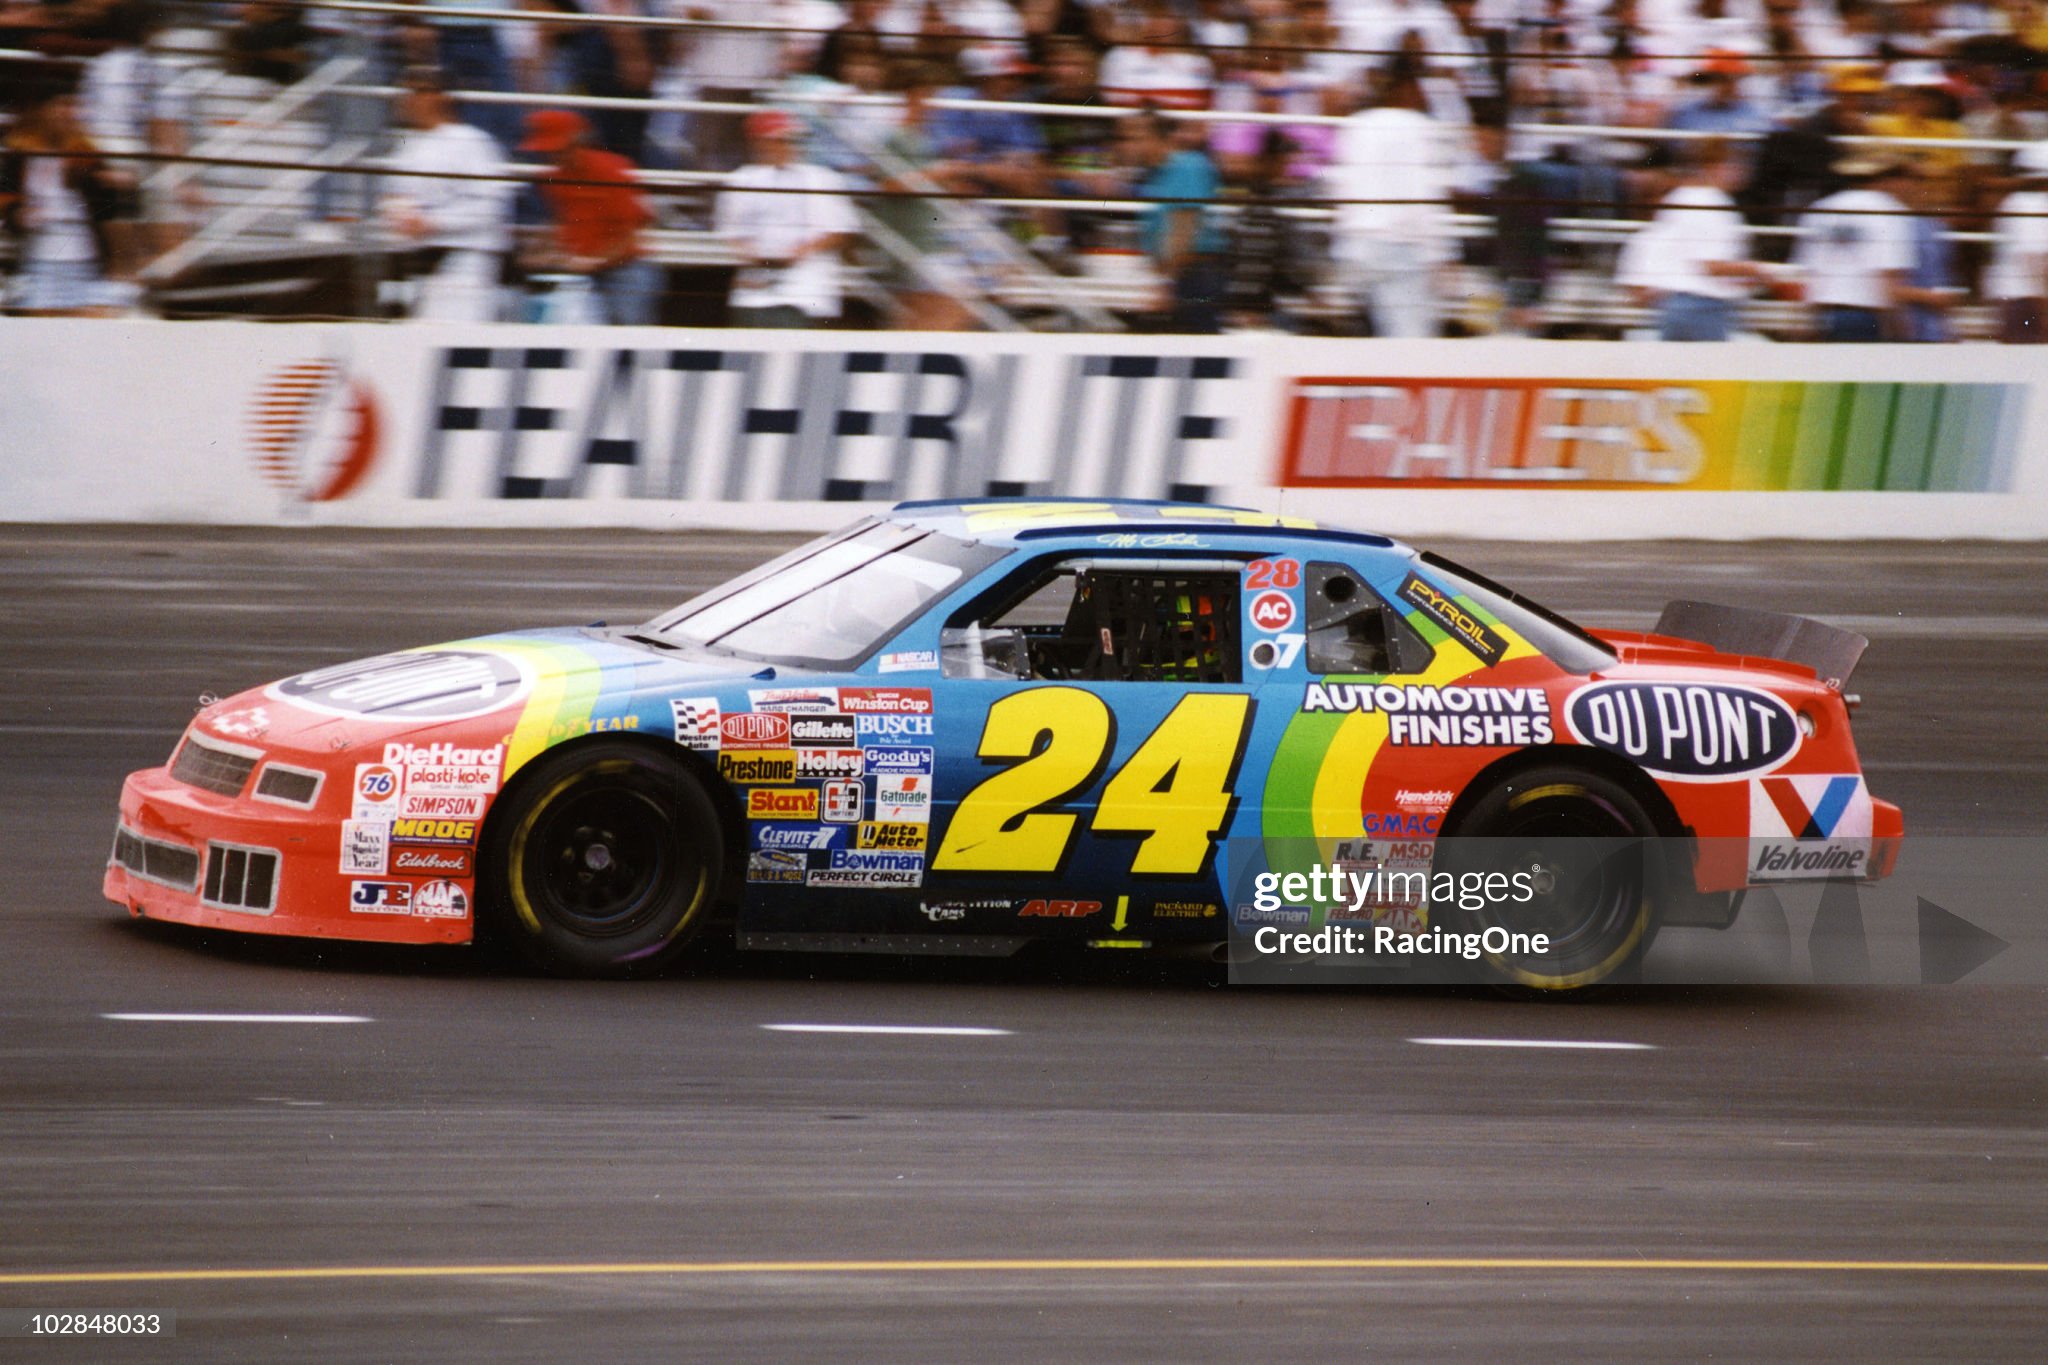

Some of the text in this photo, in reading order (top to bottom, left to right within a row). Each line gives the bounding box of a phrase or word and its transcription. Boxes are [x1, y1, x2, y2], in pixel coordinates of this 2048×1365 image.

[412, 346, 1238, 501] FEATHERLITE
[1245, 558, 1301, 590] 28
[1257, 602, 1287, 620] AC
[843, 697, 930, 713] Winston Cup
[1303, 684, 1549, 713] AUTOMOTIVE
[747, 716, 784, 738] PONT
[792, 720, 854, 738] Gillette
[858, 714, 934, 735] BUSCH
[1391, 715, 1553, 745] FINISHES
[1594, 686, 1777, 766] DU PONT
[679, 733, 719, 742] Western
[383, 742, 503, 766] DieHard
[797, 750, 862, 777] Holley
[866, 750, 930, 767] Goody's
[411, 768, 491, 784] plasti-kote
[721, 754, 793, 780] Prestone
[364, 774, 391, 793] 76
[931, 686, 1257, 880] 24
[406, 796, 477, 815] SIMPSON
[751, 791, 816, 811] Stant
[881, 790, 927, 803] Gatorade
[1395, 790, 1454, 804] Hendrick
[392, 820, 476, 839] MOOG
[880, 824, 917, 836] Auto
[1363, 814, 1438, 834] GMAC
[876, 836, 924, 847] Meter
[395, 852, 465, 870] Edelbrock
[832, 850, 923, 869] Bowman
[1389, 844, 1433, 859] MSD
[1756, 845, 1864, 873] Valvoline
[811, 872, 917, 882] PERFECT CIRCLE
[353, 883, 409, 906] JE
[1018, 900, 1102, 917] ARP
